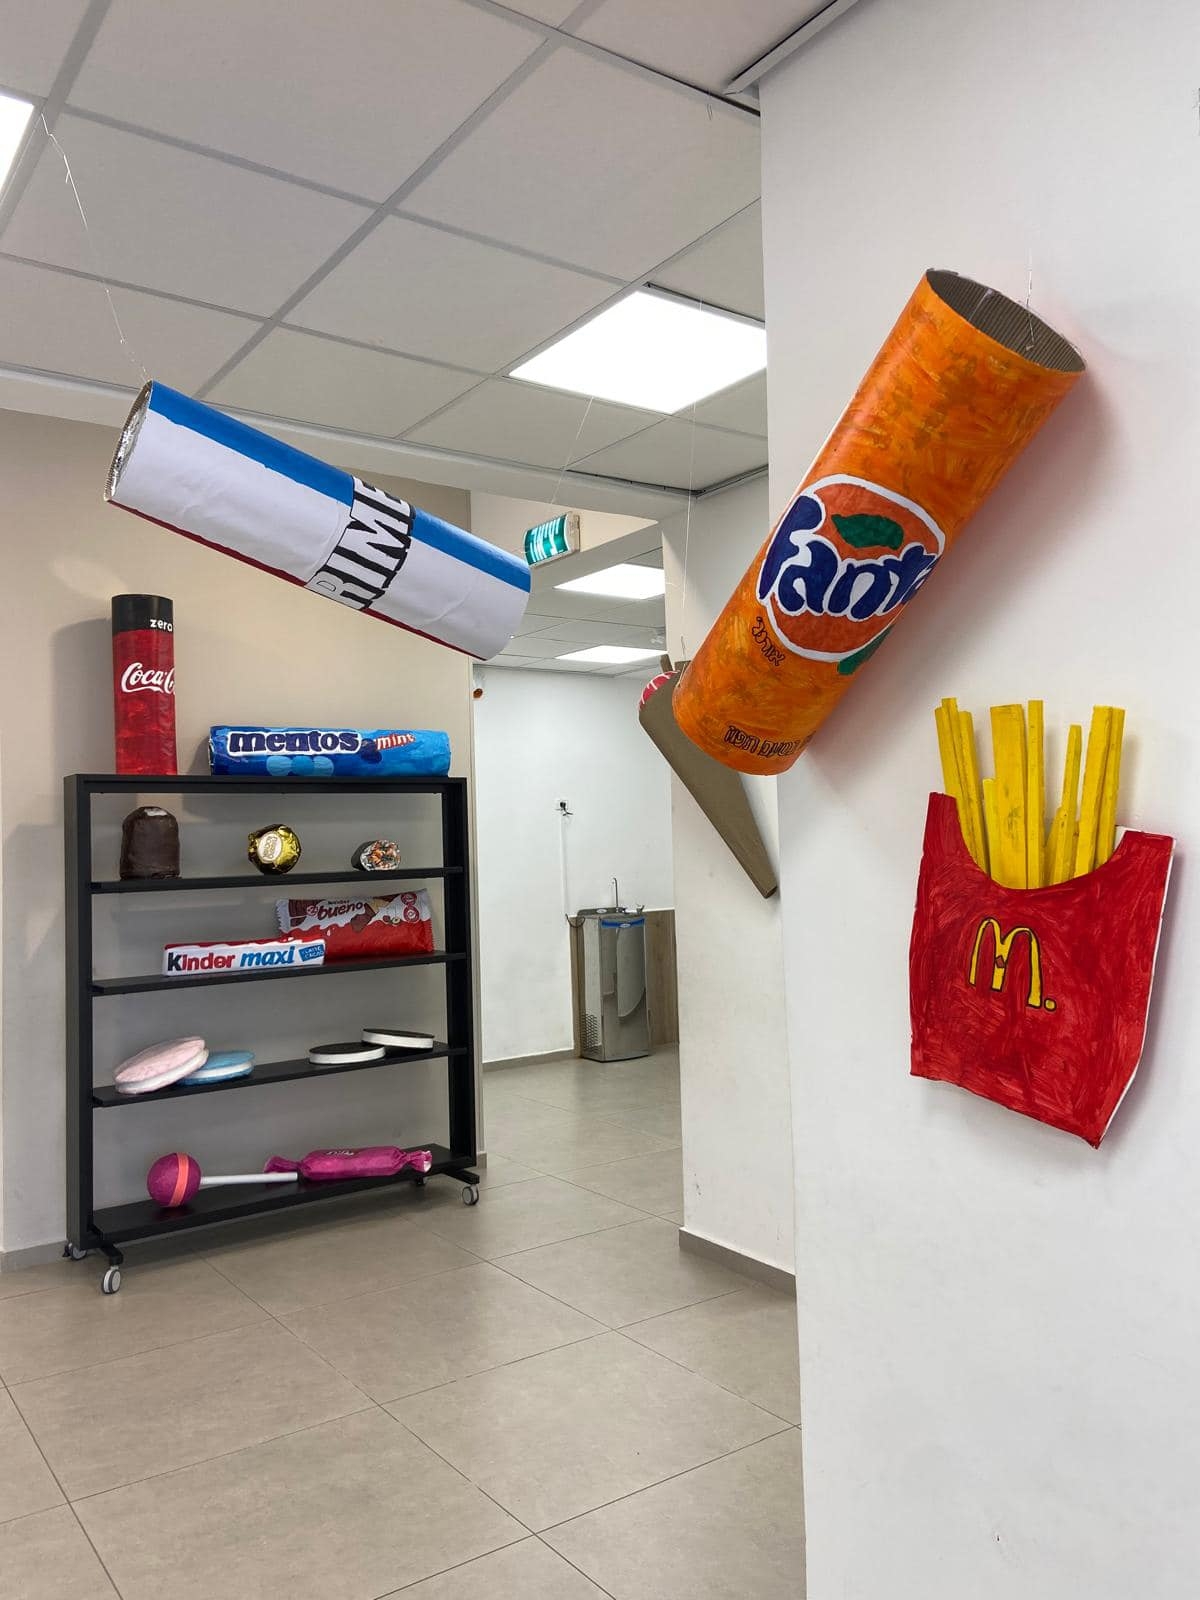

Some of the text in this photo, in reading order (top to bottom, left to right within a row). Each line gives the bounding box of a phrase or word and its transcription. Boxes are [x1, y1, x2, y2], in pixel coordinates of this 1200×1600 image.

[150, 618, 174, 632] zero
[228, 731, 416, 753] mentos mint
[318, 902, 363, 921] bueno
[240, 945, 296, 968] maxi
